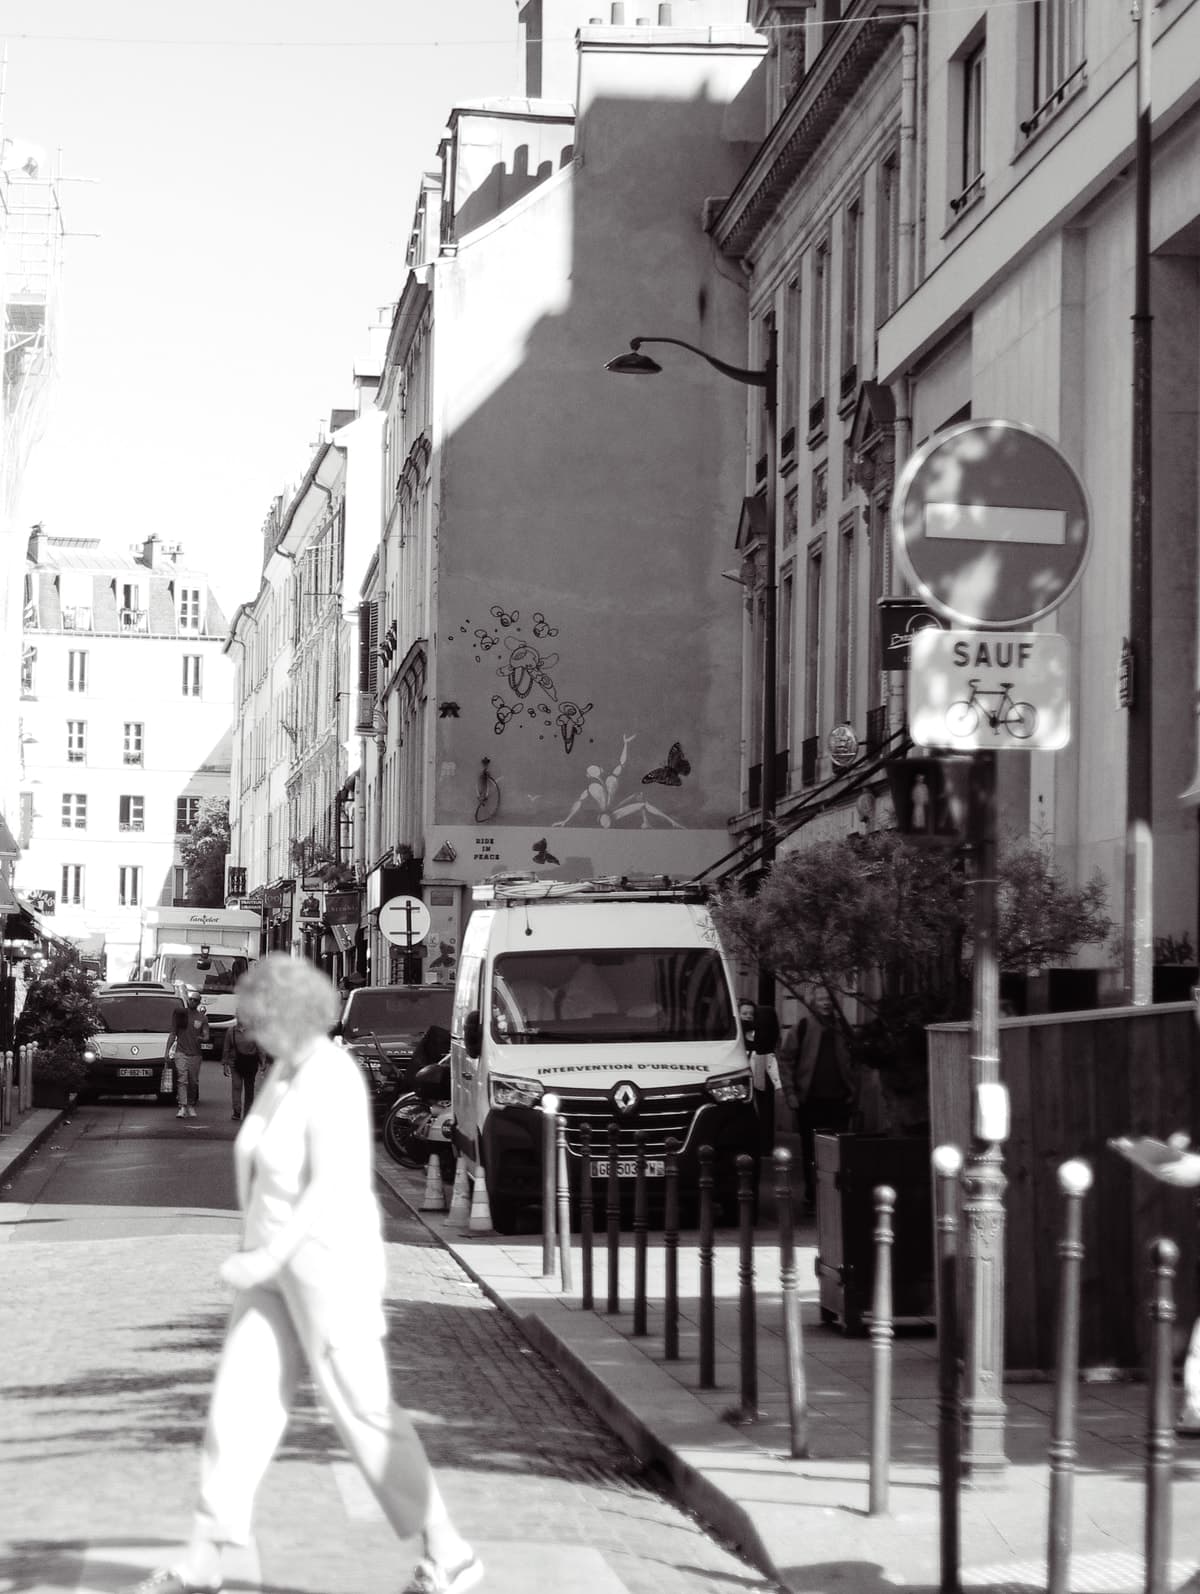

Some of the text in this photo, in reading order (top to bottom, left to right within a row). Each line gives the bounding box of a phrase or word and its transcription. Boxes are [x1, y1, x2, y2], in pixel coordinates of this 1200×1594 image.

[952, 640, 1034, 669] SAUF
[537, 1063, 711, 1075] INTERVENTION D'URGENCE
